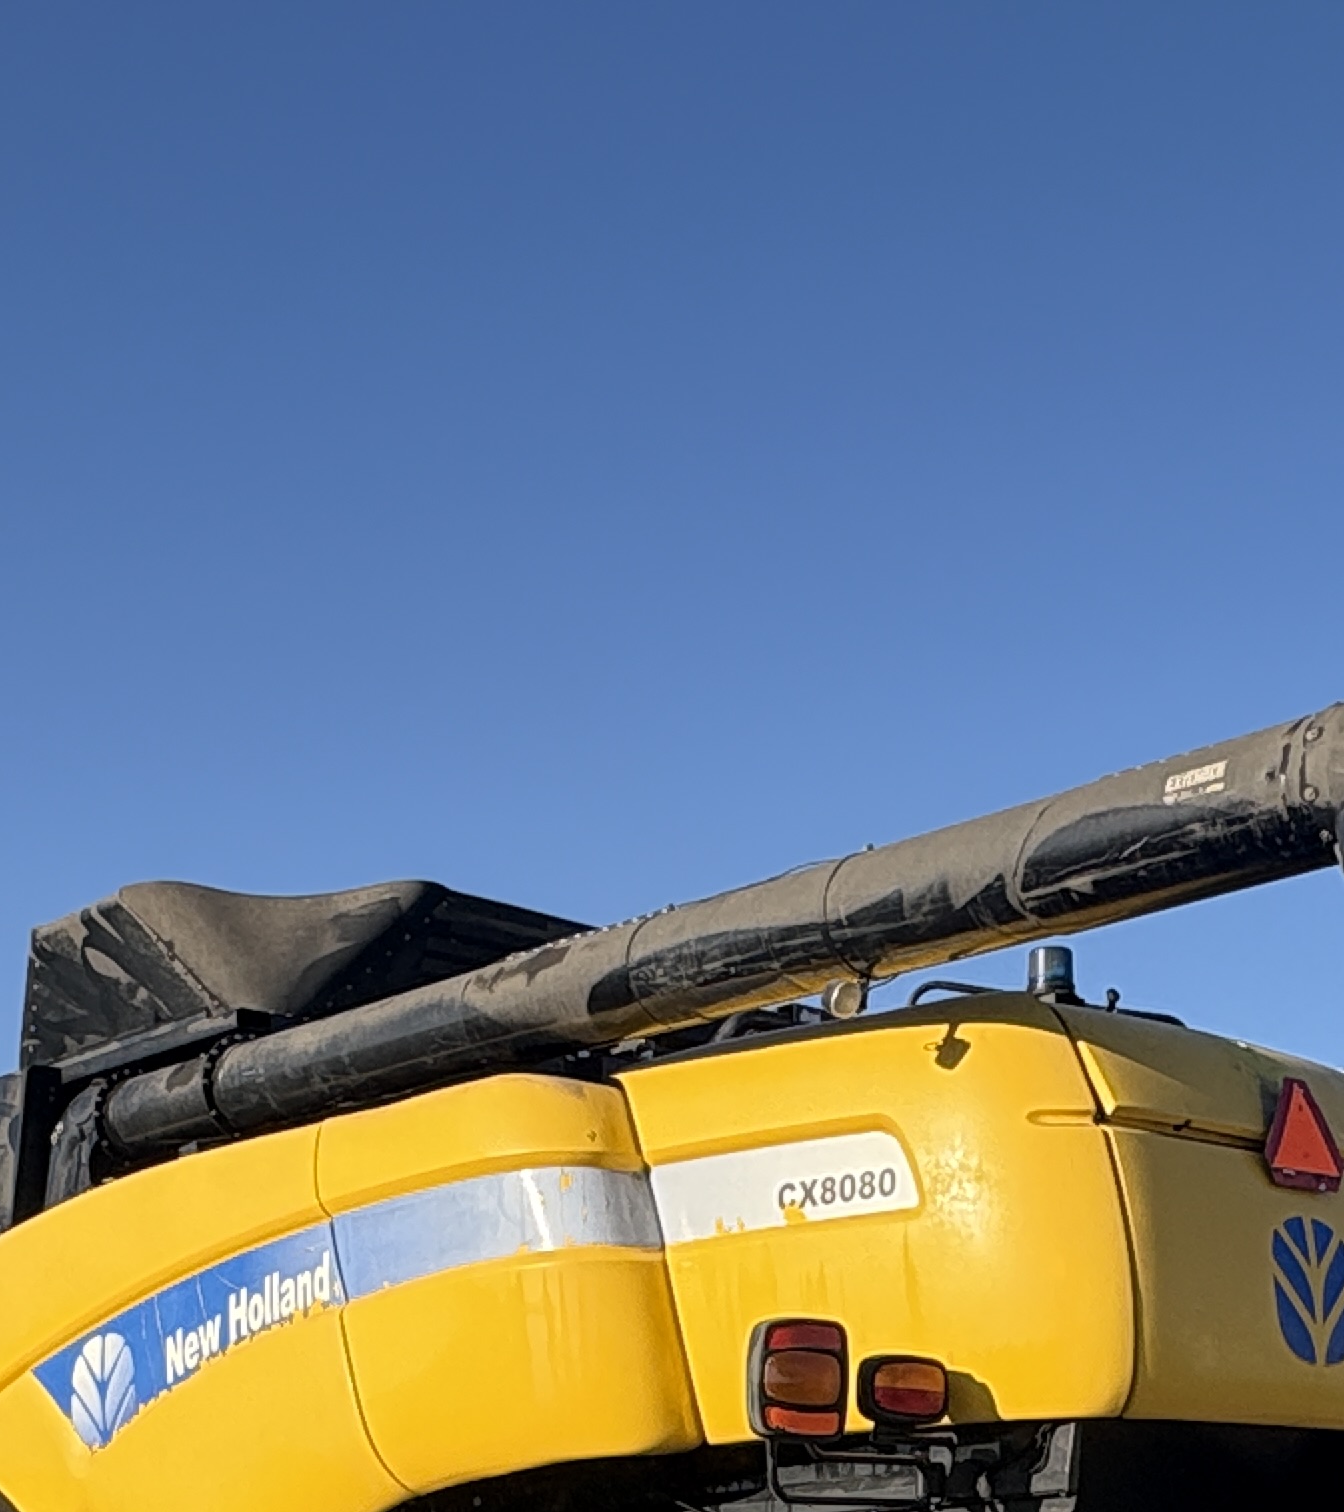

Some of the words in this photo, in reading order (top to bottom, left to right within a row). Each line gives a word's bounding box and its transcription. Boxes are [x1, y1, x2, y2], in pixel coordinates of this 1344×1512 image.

[777, 1167, 896, 1210] CX8080
[165, 1312, 223, 1384] New
[228, 1250, 331, 1345] Holland
